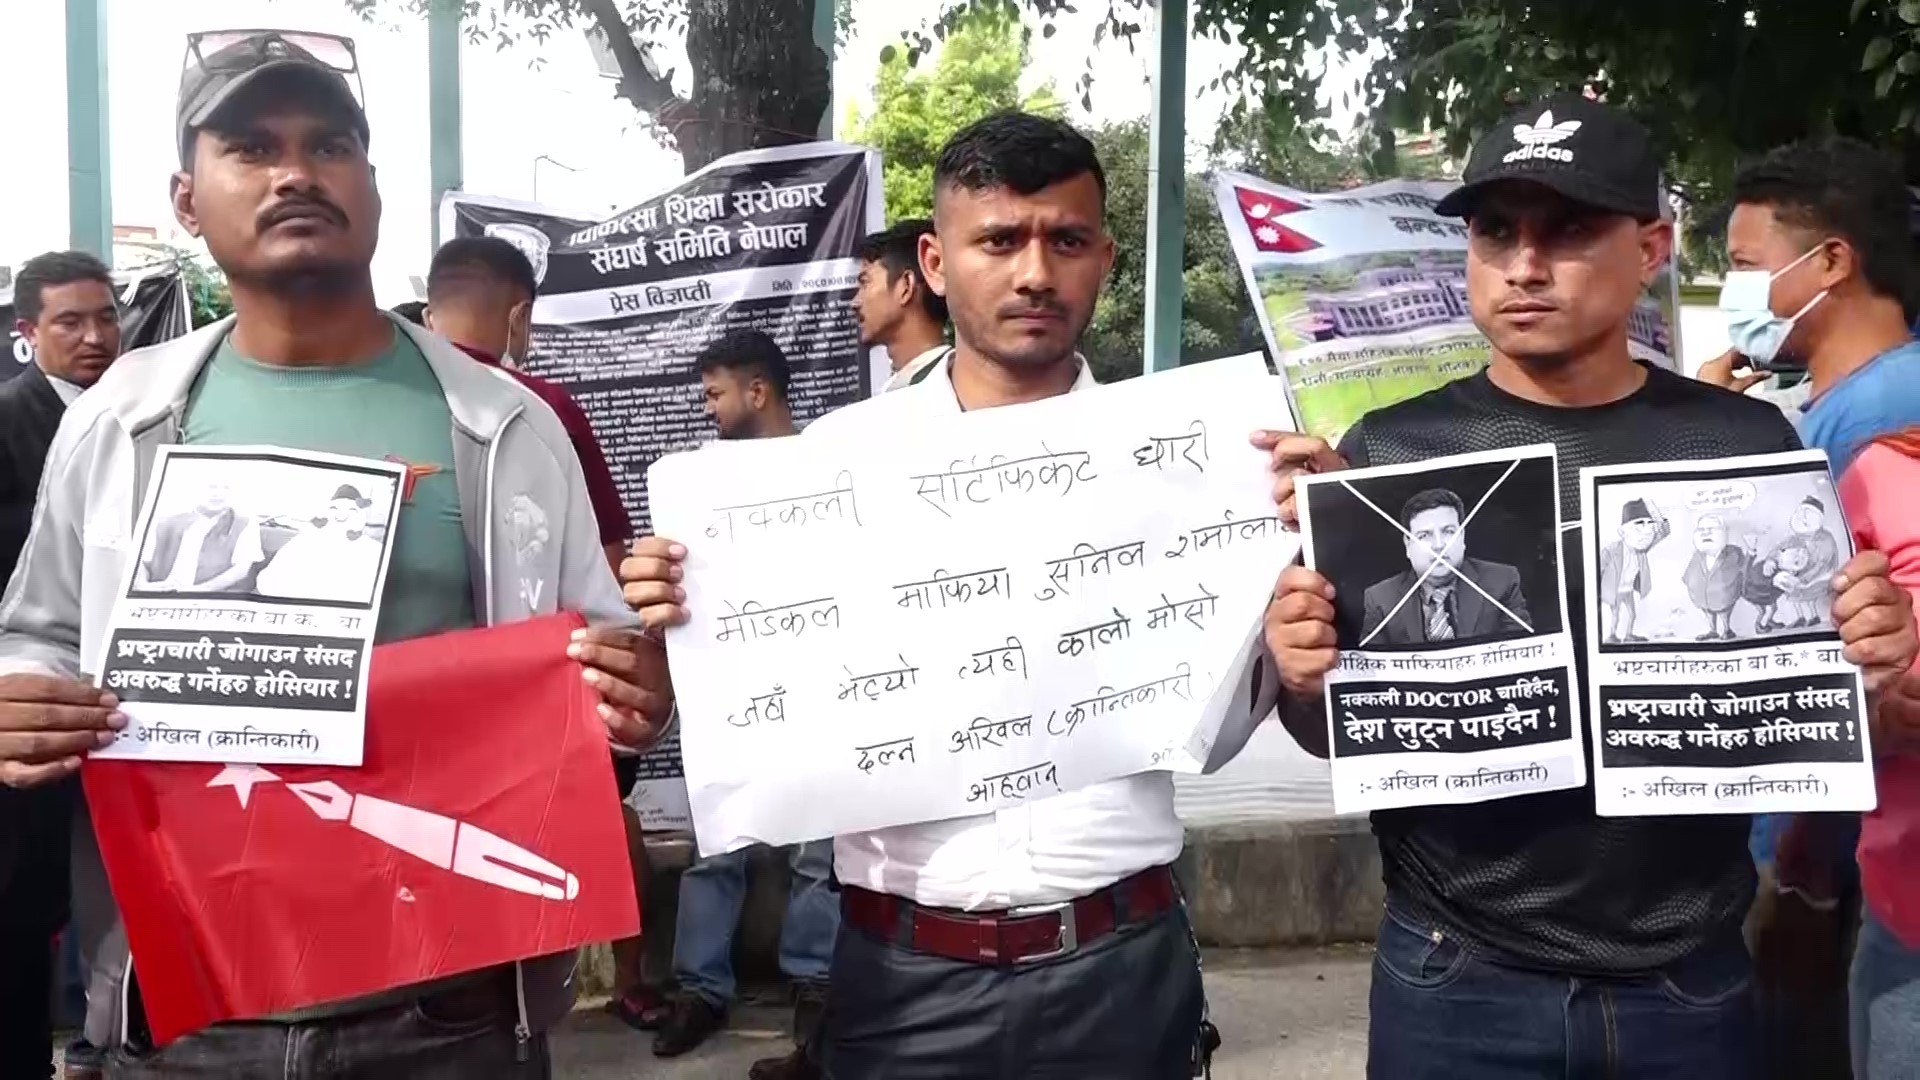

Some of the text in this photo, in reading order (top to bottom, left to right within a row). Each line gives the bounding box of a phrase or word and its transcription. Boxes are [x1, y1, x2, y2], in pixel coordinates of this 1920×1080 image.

[1503, 143, 1574, 163] adidas
[664, 193, 726, 226] शिक्षा
[732, 181, 828, 218] सरोकार
[588, 236, 648, 275] संघर्ष
[654, 225, 731, 266] समिति
[737, 222, 809, 251] नेपाल
[609, 279, 713, 315] प्रेस विज्ञप्ती
[716, 509, 1291, 644] मेडिकल माफिया सुनिल शर्माला
[218, 636, 301, 665] जोगाउन
[303, 643, 357, 669] संसद
[727, 682, 787, 727] जहाँ
[959, 637, 1028, 680] त्यही
[1057, 606, 1132, 657] कालो
[1147, 582, 1220, 631] मोसो
[1390, 654, 1477, 672] माफियाहरु
[1481, 644, 1545, 668] होसियार
[107, 669, 185, 694] अवरुद्ध
[254, 669, 340, 699] होसियार
[344, 679, 353, 699] !
[1339, 686, 1401, 708] नक्कली
[1405, 688, 1493, 708] DOCTOR
[1711, 691, 1791, 716] जोगाउन
[1794, 686, 1851, 711] संसद
[136, 721, 201, 745] अखिल
[207, 725, 320, 753] (क्रान्तिकारी)
[948, 714, 1033, 753] अखिल
[1343, 702, 1558, 750] देश लुट्न पाइदैन !
[1606, 729, 1682, 750] अवरुद्ध
[1753, 718, 1840, 746] होसियार
[1846, 720, 1855, 741] !
[1378, 769, 1439, 792] अखिल
[1445, 762, 1549, 791] (क्रान्तिकारी)
[1642, 775, 1709, 798] अखिल
[1714, 774, 1829, 798] (क्रान्तिकारी)
